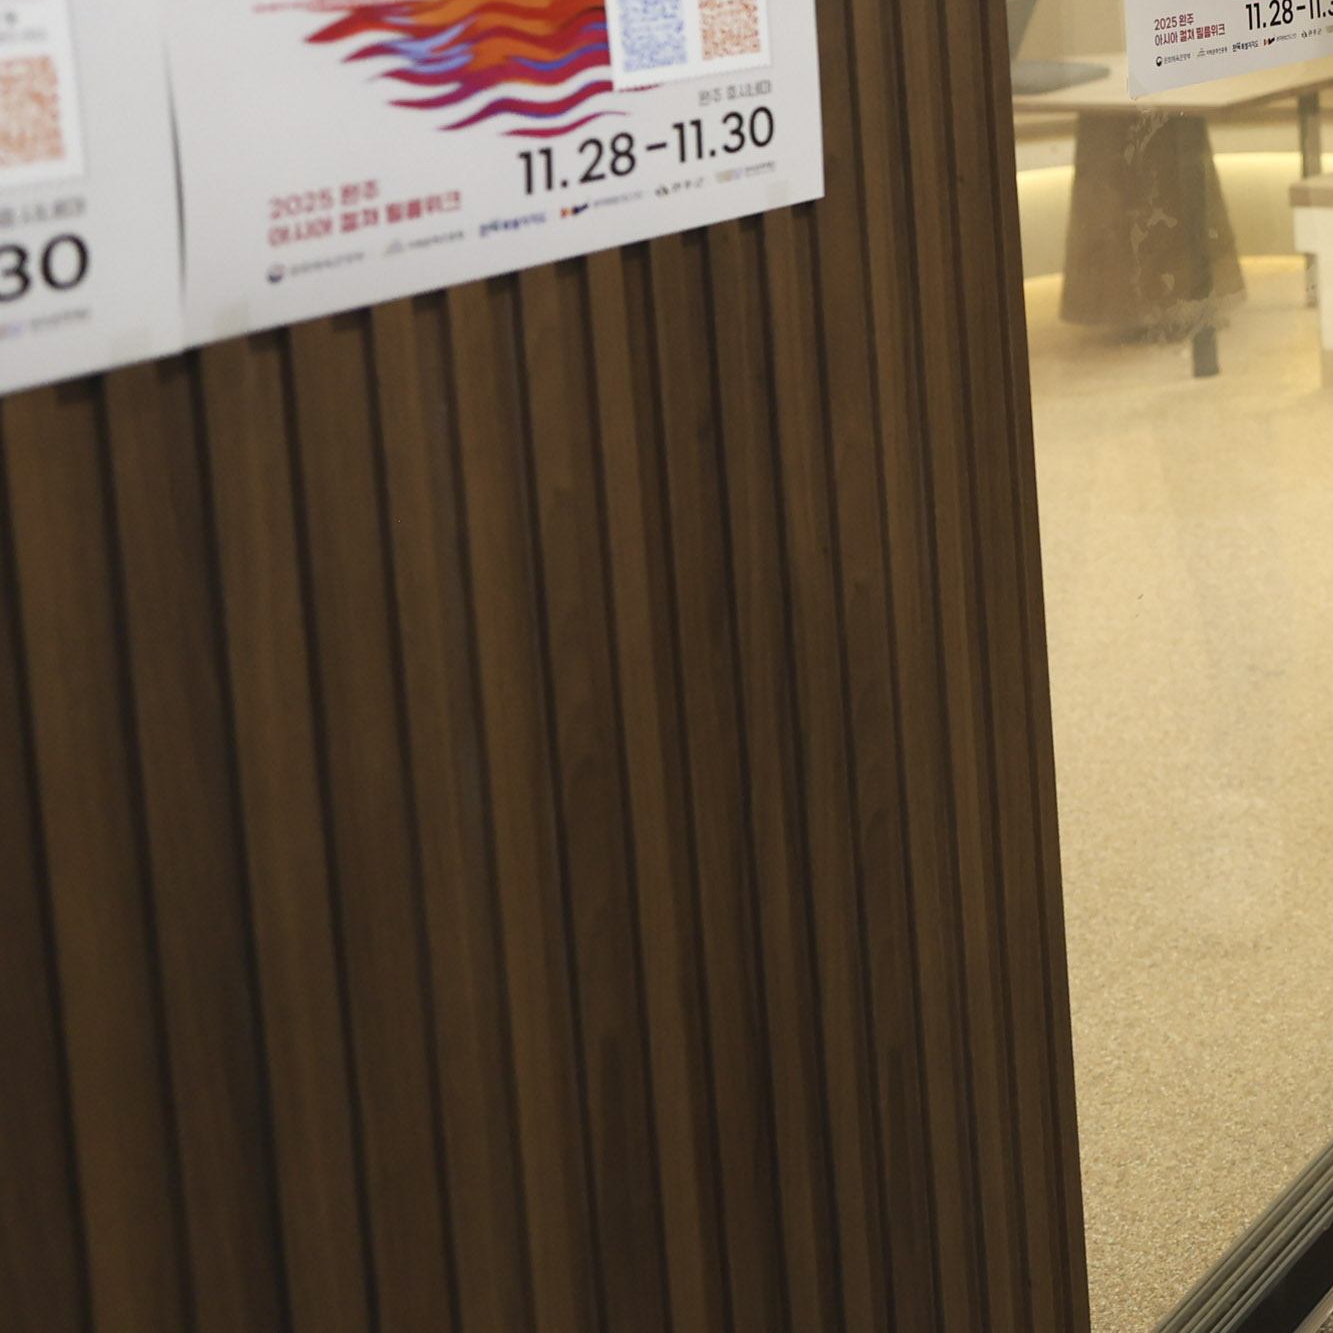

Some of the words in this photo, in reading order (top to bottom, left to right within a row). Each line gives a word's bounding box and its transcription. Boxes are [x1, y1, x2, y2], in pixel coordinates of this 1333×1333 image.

[1154, 16, 1178, 31] 2025
[1179, 13, 1194, 27] 완주
[1155, 31, 1179, 47] 아시아
[1196, 23, 1226, 40] 필름위크
[270, 189, 333, 219] 2025
